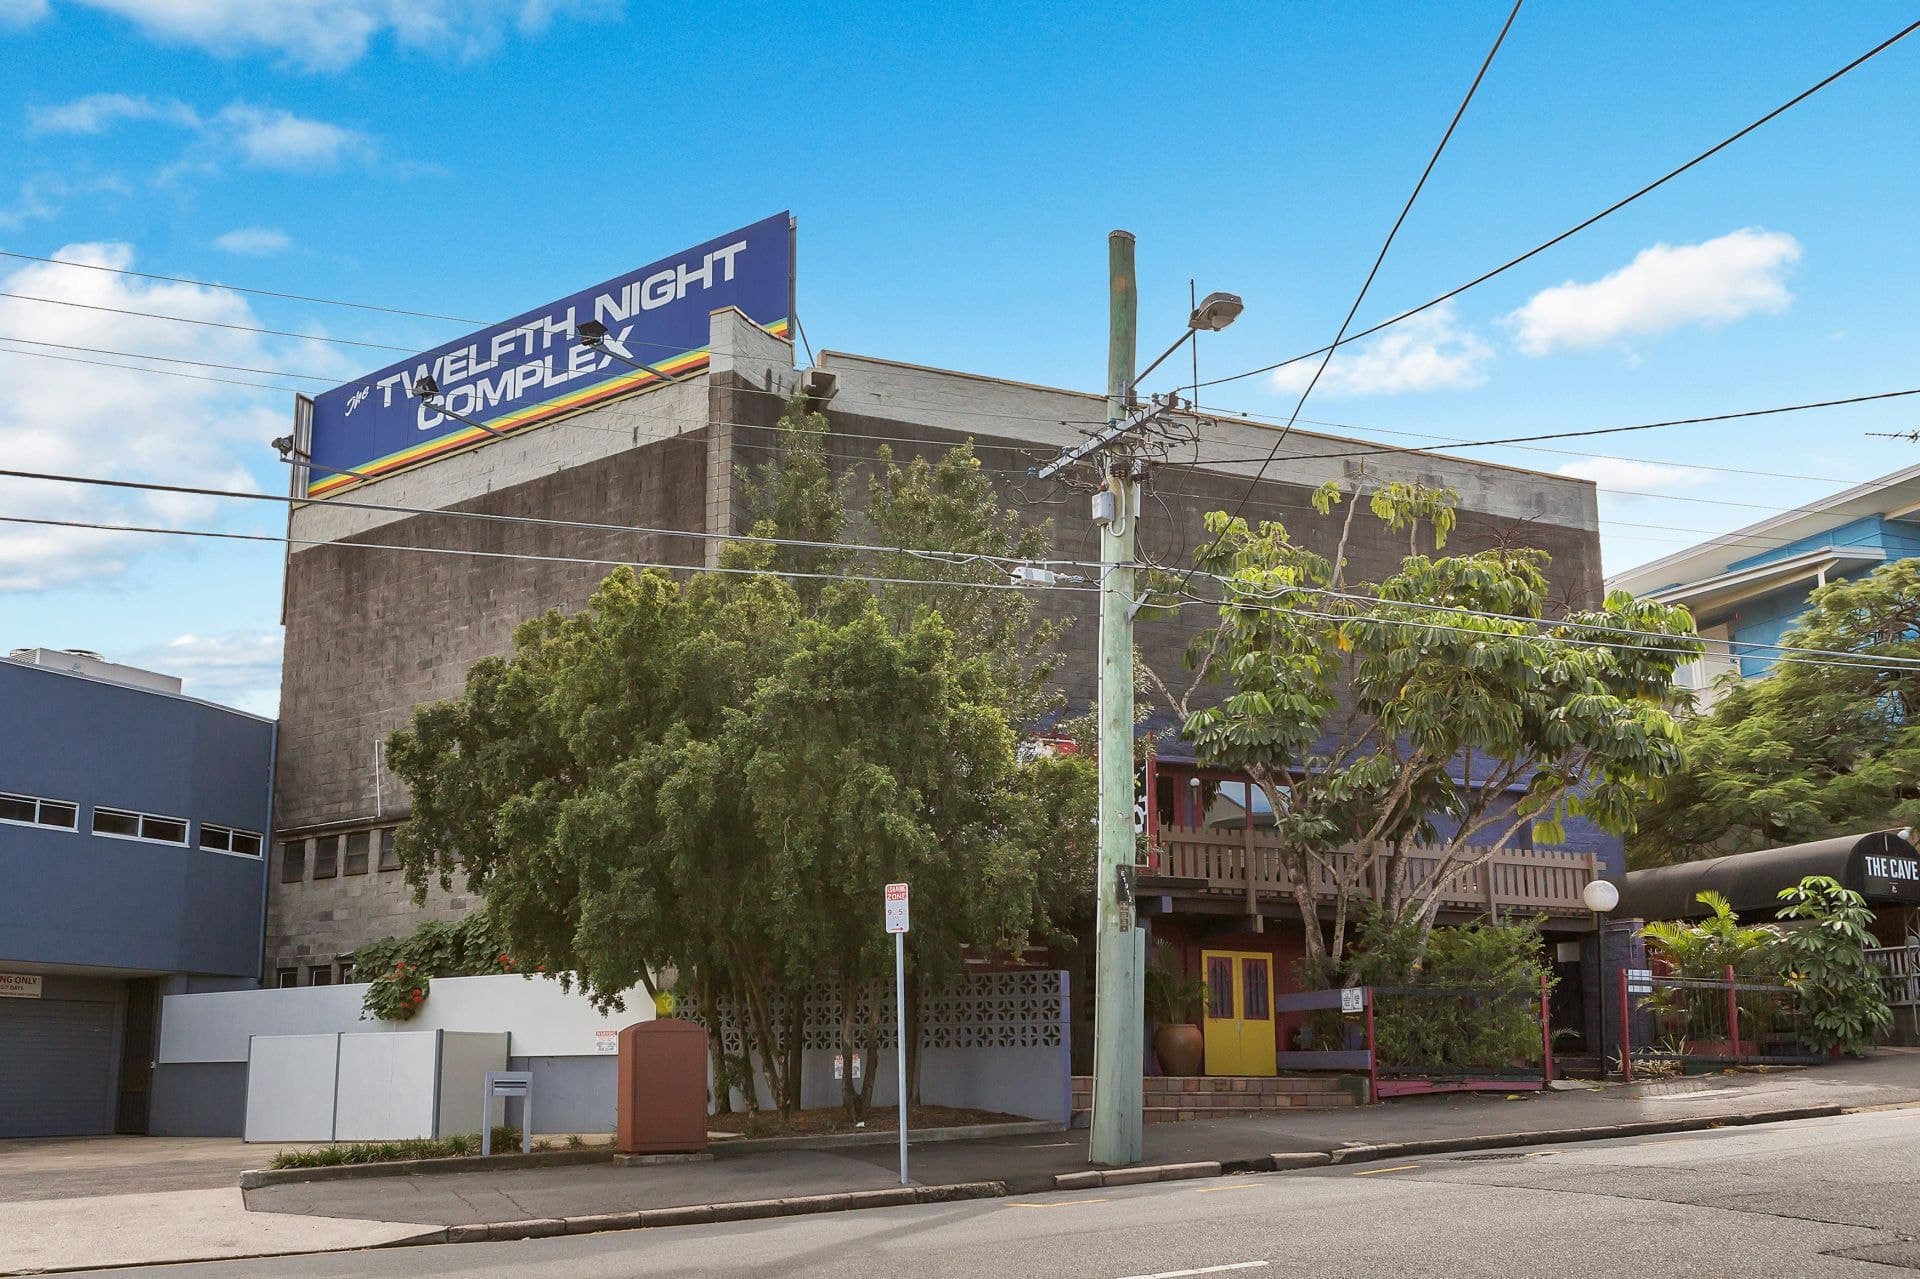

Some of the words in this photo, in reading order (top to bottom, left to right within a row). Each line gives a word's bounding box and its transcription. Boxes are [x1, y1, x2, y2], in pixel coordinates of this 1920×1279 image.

[345, 386, 371, 417] The
[376, 306, 576, 408] TWELFTH
[594, 240, 747, 326] NIGHT
[417, 325, 635, 431] COMPLEX
[1865, 856, 1889, 878] THE
[1890, 859, 1919, 880] CAVE
[15, 976, 37, 984] ONLY
